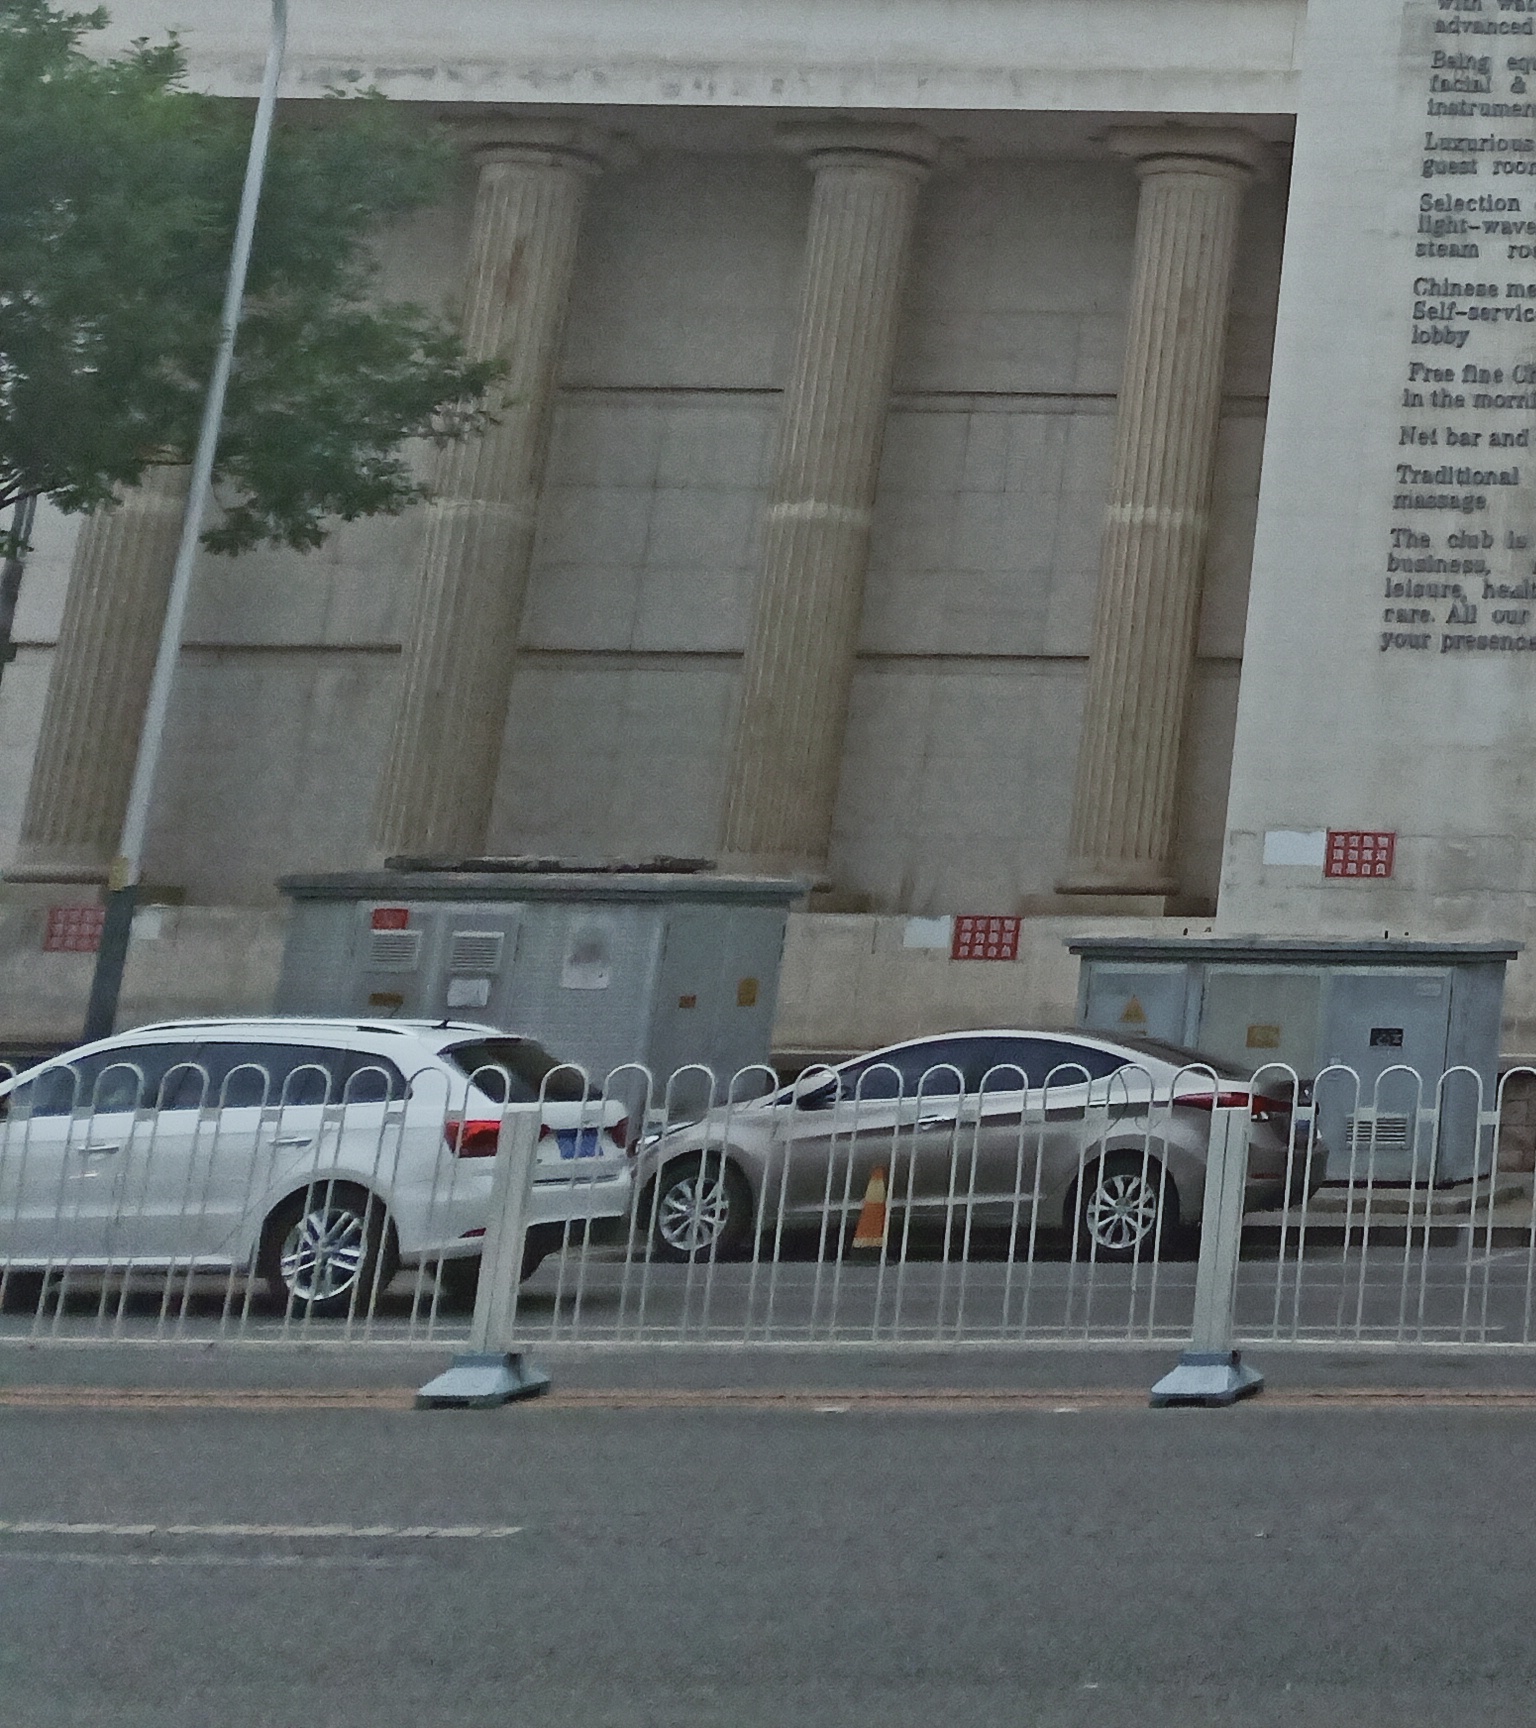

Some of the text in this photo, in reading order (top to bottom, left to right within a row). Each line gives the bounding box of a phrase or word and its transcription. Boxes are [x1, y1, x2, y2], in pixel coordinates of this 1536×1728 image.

[1434, 15, 1534, 35] advanced
[1431, 50, 1491, 74] Being
[1430, 74, 1492, 93] facial
[1510, 76, 1526, 94] &
[1424, 131, 1535, 151] Luxurious
[1422, 159, 1477, 178] guest
[1419, 193, 1520, 212] Selection
[1415, 242, 1479, 258] steam
[1413, 277, 1499, 297] Chinese
[1412, 325, 1470, 348] lobby
[1408, 361, 1455, 382] Free
[1462, 364, 1504, 384] fine
[1431, 388, 1465, 407] the
[1399, 426, 1438, 446] Net
[1446, 427, 1482, 447] bar
[1489, 429, 1529, 447] and
[1397, 464, 1519, 486] Traditional
[1393, 493, 1487, 514] massage
[1390, 528, 1430, 548] The
[1448, 529, 1494, 549] club
[1507, 531, 1527, 549] is
[1446, 603, 1477, 623] All
[1492, 609, 1530, 624] our
[1381, 632, 1431, 651] your
